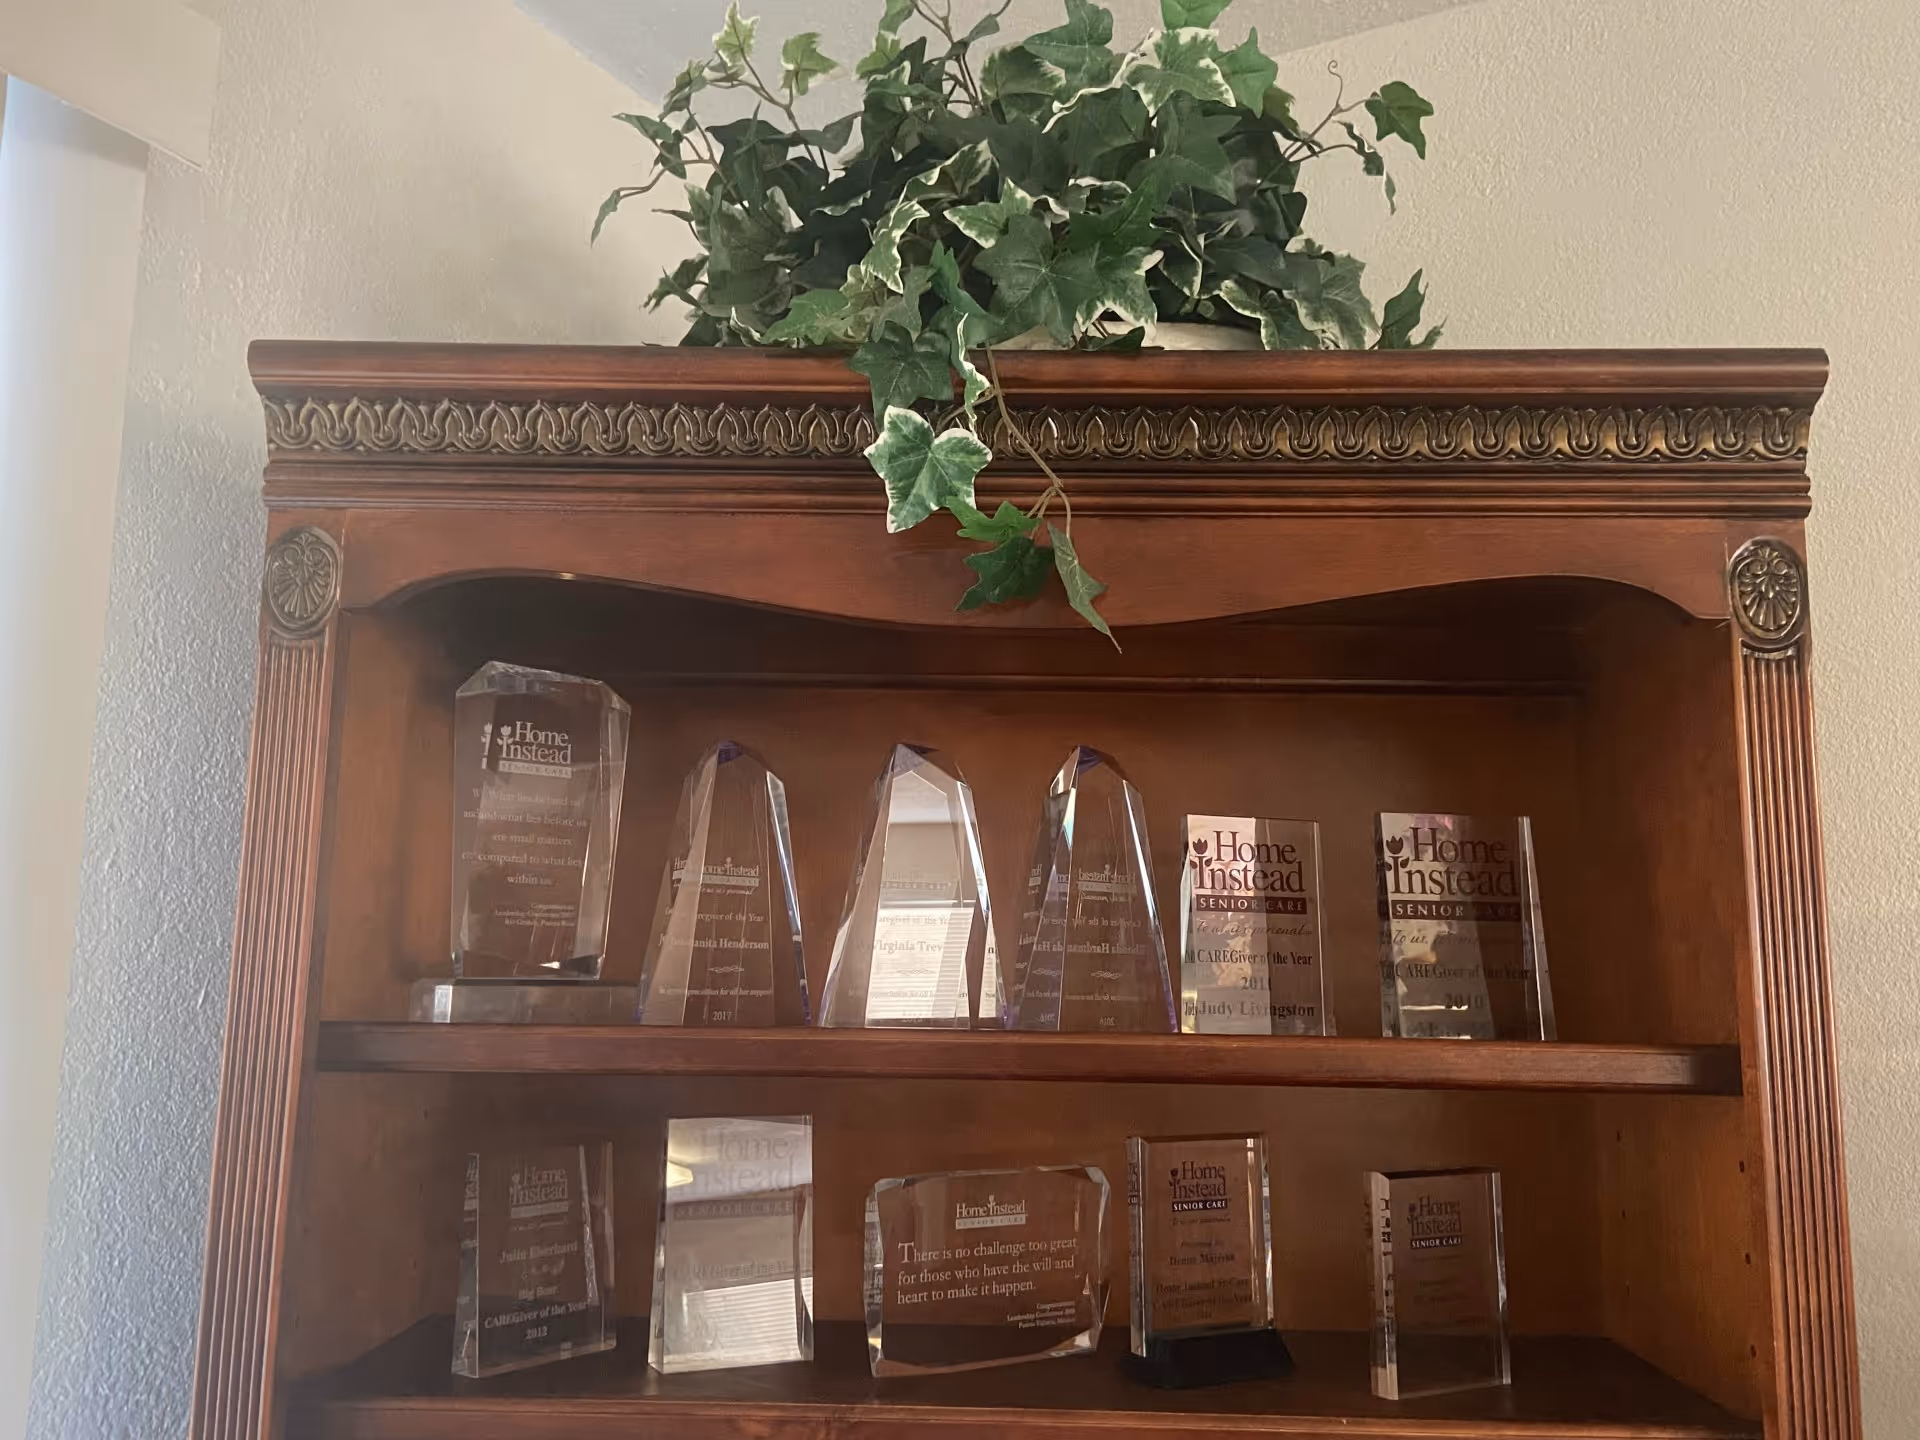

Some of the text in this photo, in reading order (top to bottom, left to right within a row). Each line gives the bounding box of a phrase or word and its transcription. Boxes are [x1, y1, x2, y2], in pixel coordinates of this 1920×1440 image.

[515, 720, 569, 747] Home
[499, 737, 572, 765] Instead
[1212, 830, 1298, 864] Home
[1409, 826, 1508, 864] Home
[725, 861, 759, 876] Instead
[1193, 855, 1307, 893] Instead
[1387, 855, 1520, 897] Instead
[1199, 897, 1305, 912] SENIOR CARE
[1395, 903, 1465, 918] SENIOR
[748, 913, 765, 923] Year
[719, 937, 770, 950] Henderson
[1392, 929, 1407, 945] To
[1197, 948, 1258, 965] CAREGiver
[1272, 951, 1288, 965] the
[1289, 951, 1313, 966] Year
[712, 1010, 733, 1021] 2017
[1199, 1001, 1233, 1019] Judy
[527, 1165, 568, 1185] Home
[1181, 1160, 1227, 1181] Home
[510, 1179, 568, 1205] Instead
[1171, 1176, 1227, 1200] Instead
[955, 1199, 1025, 1218] Home Instead
[1173, 1200, 1226, 1212] SENIOR CARE
[1417, 1193, 1461, 1216] Home
[1410, 1211, 1462, 1236] Instead
[898, 1238, 1077, 1264] There is no challenge too great
[1411, 1238, 1441, 1249] SENIOR
[897, 1254, 1075, 1286] for those who have the will and
[897, 1281, 1036, 1305] heart to make it happen.
[484, 1311, 539, 1329] CAREGiver
[540, 1305, 550, 1318] of
[551, 1304, 566, 1316] the
